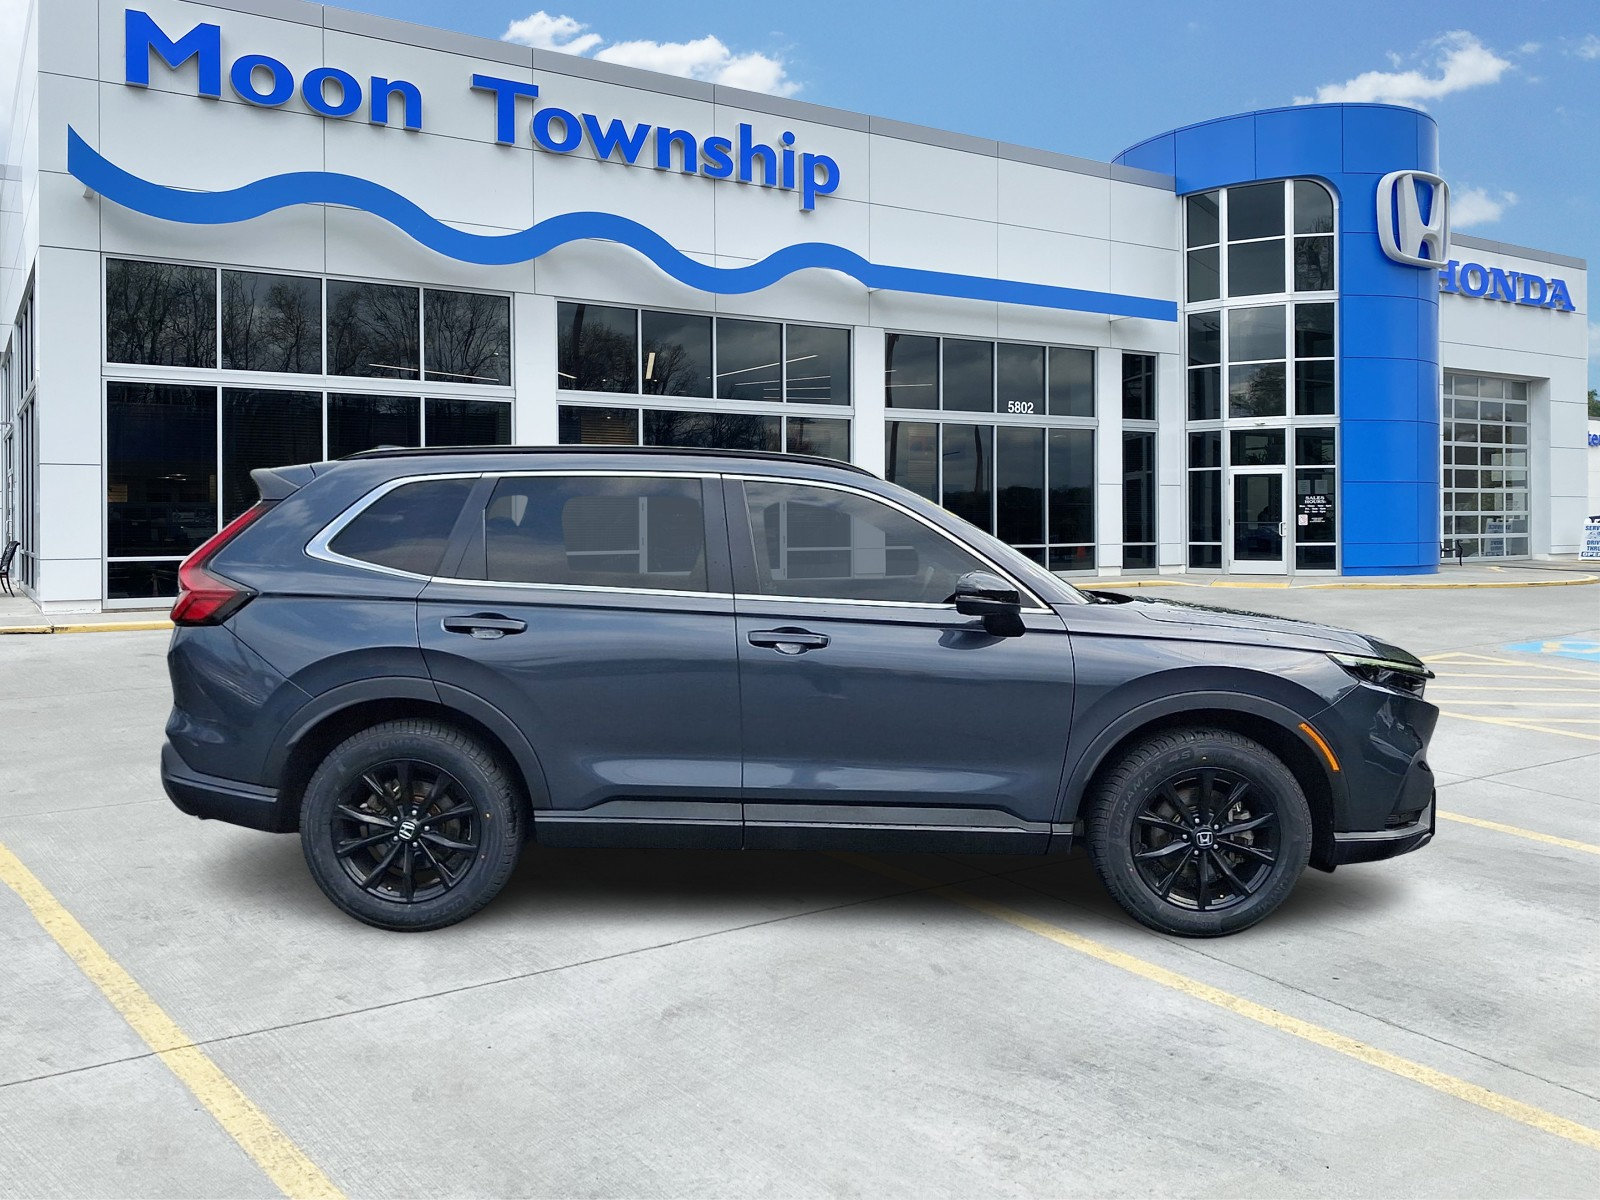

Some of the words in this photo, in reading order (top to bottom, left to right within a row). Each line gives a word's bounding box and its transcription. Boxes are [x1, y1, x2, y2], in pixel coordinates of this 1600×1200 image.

[125, 8, 423, 131] Moon
[470, 73, 842, 212] Township
[1007, 400, 1034, 414] 5802
